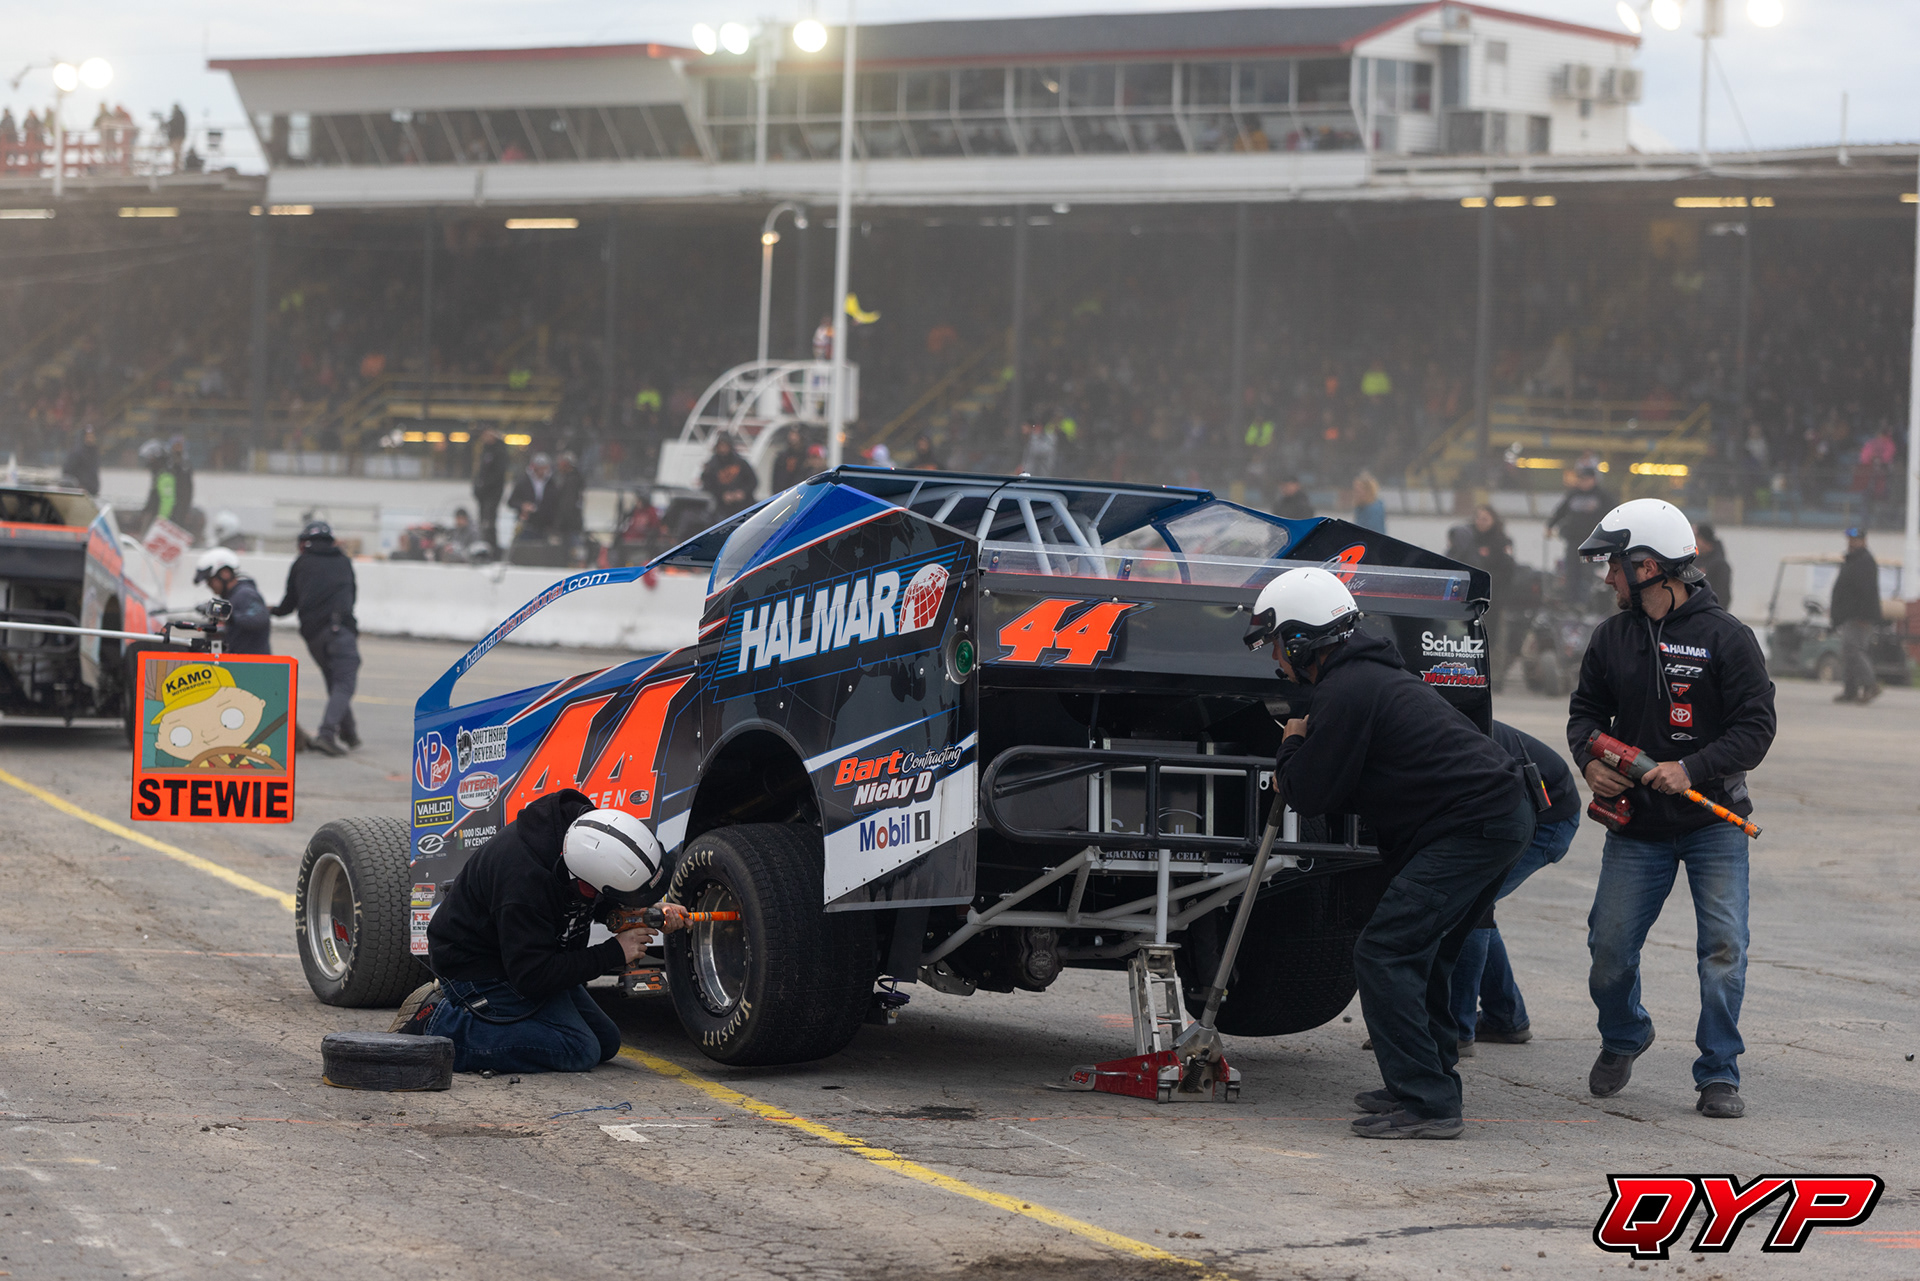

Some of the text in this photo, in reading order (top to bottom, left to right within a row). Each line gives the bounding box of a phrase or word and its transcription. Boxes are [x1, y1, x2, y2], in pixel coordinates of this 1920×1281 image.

[465, 572, 610, 669] halmarinternational.com
[738, 571, 900, 672] HALMAR
[998, 598, 1139, 665] 44
[1421, 630, 1484, 653] Schultz
[1669, 644, 1707, 658] HALMAR
[166, 669, 212, 693] KAMO
[171, 680, 211, 696] MOTORSPORTS
[1424, 672, 1486, 686] Morrison
[472, 727, 507, 745] SOUTHSIDE
[417, 732, 442, 790] VP
[473, 743, 505, 762] BEVERAGE
[504, 673, 695, 827] 44
[834, 744, 962, 786] Bart Contracting
[137, 778, 288, 819] STEWIE
[459, 777, 499, 798] INTEGRA
[588, 789, 627, 809] SEN
[853, 771, 932, 806] Nicky D
[417, 801, 452, 815] VAHLCO
[463, 825, 497, 839] 1000 ISLANDS
[464, 836, 492, 848] RV CENTR
[860, 814, 910, 852] Mobil
[1106, 850, 1204, 861] RACING FUL CELL
[668, 846, 714, 905] Hoosier
[703, 990, 752, 1050] Hoosier
